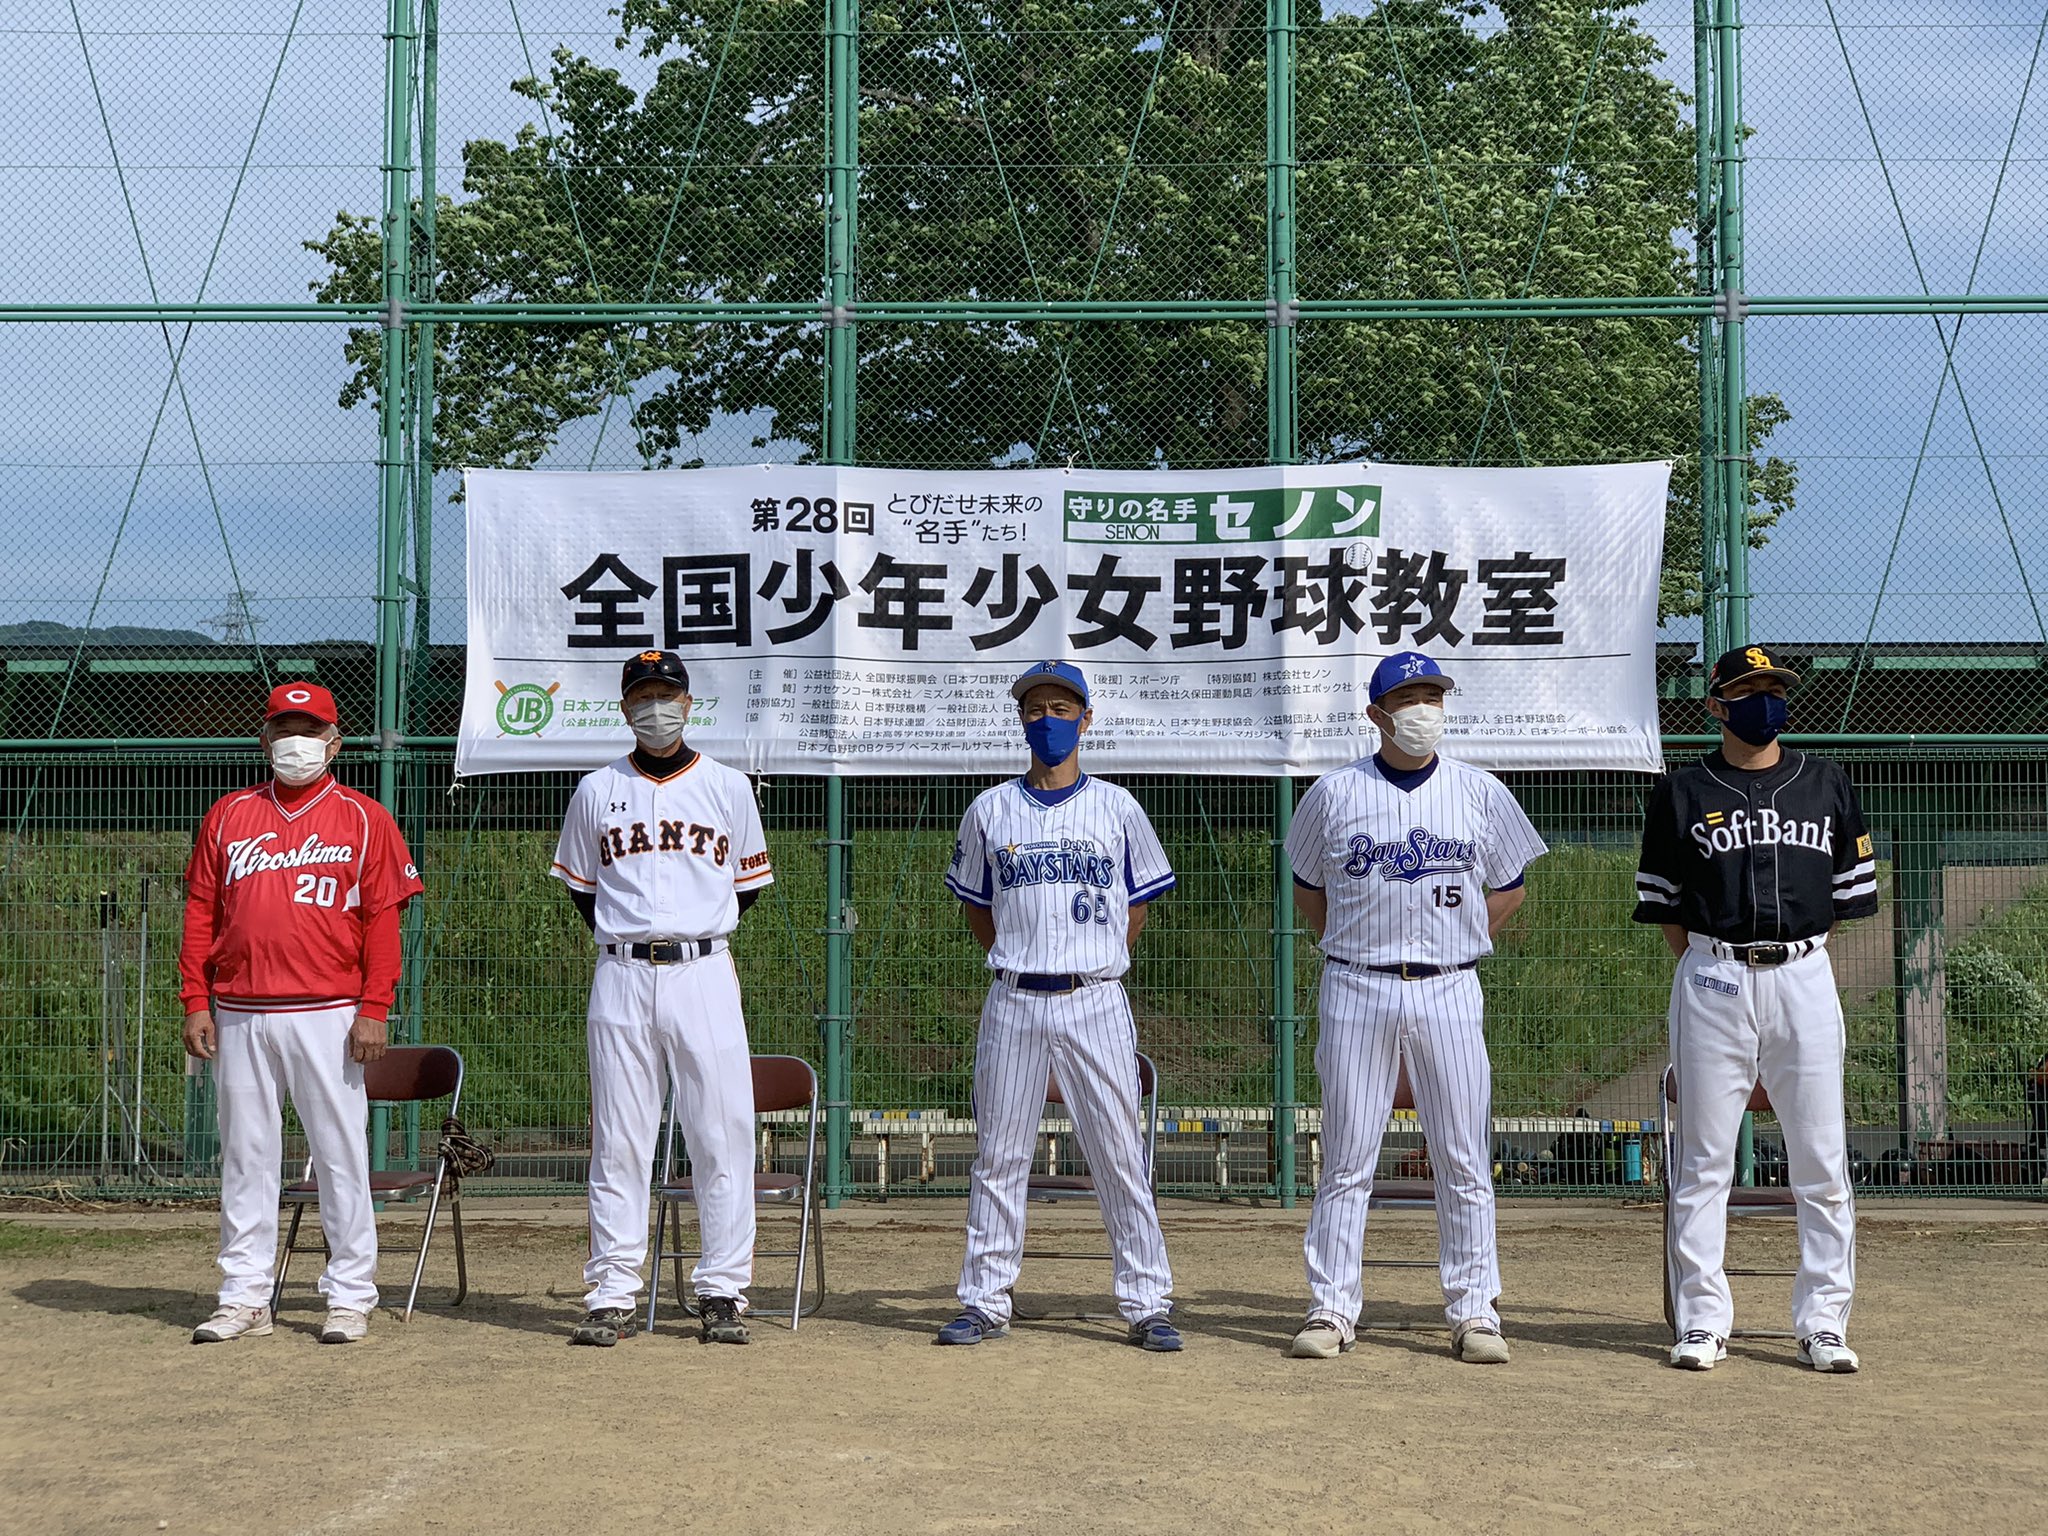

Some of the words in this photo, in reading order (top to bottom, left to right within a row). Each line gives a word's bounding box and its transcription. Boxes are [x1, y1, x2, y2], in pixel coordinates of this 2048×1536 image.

[750, 497, 875, 536] 第28回
[887, 493, 1043, 515] とびだせ未来の
[1068, 497, 1198, 521] 守りの名手
[1209, 489, 1377, 540] セノン
[1105, 524, 1160, 540] SENON
[560, 547, 1567, 652] 全国少年少女野球教室
[286, 690, 311, 703] C
[507, 697, 543, 723] JB
[600, 820, 729, 867] GIANTS
[1061, 838, 1096, 853] DeNA
[1690, 808, 1833, 860] SoftBank
[224, 831, 353, 886] Hiroshima
[740, 851, 768, 871] YOMI
[1343, 826, 1478, 884] BayStars
[293, 873, 338, 908] 20
[1432, 885, 1463, 909] 15
